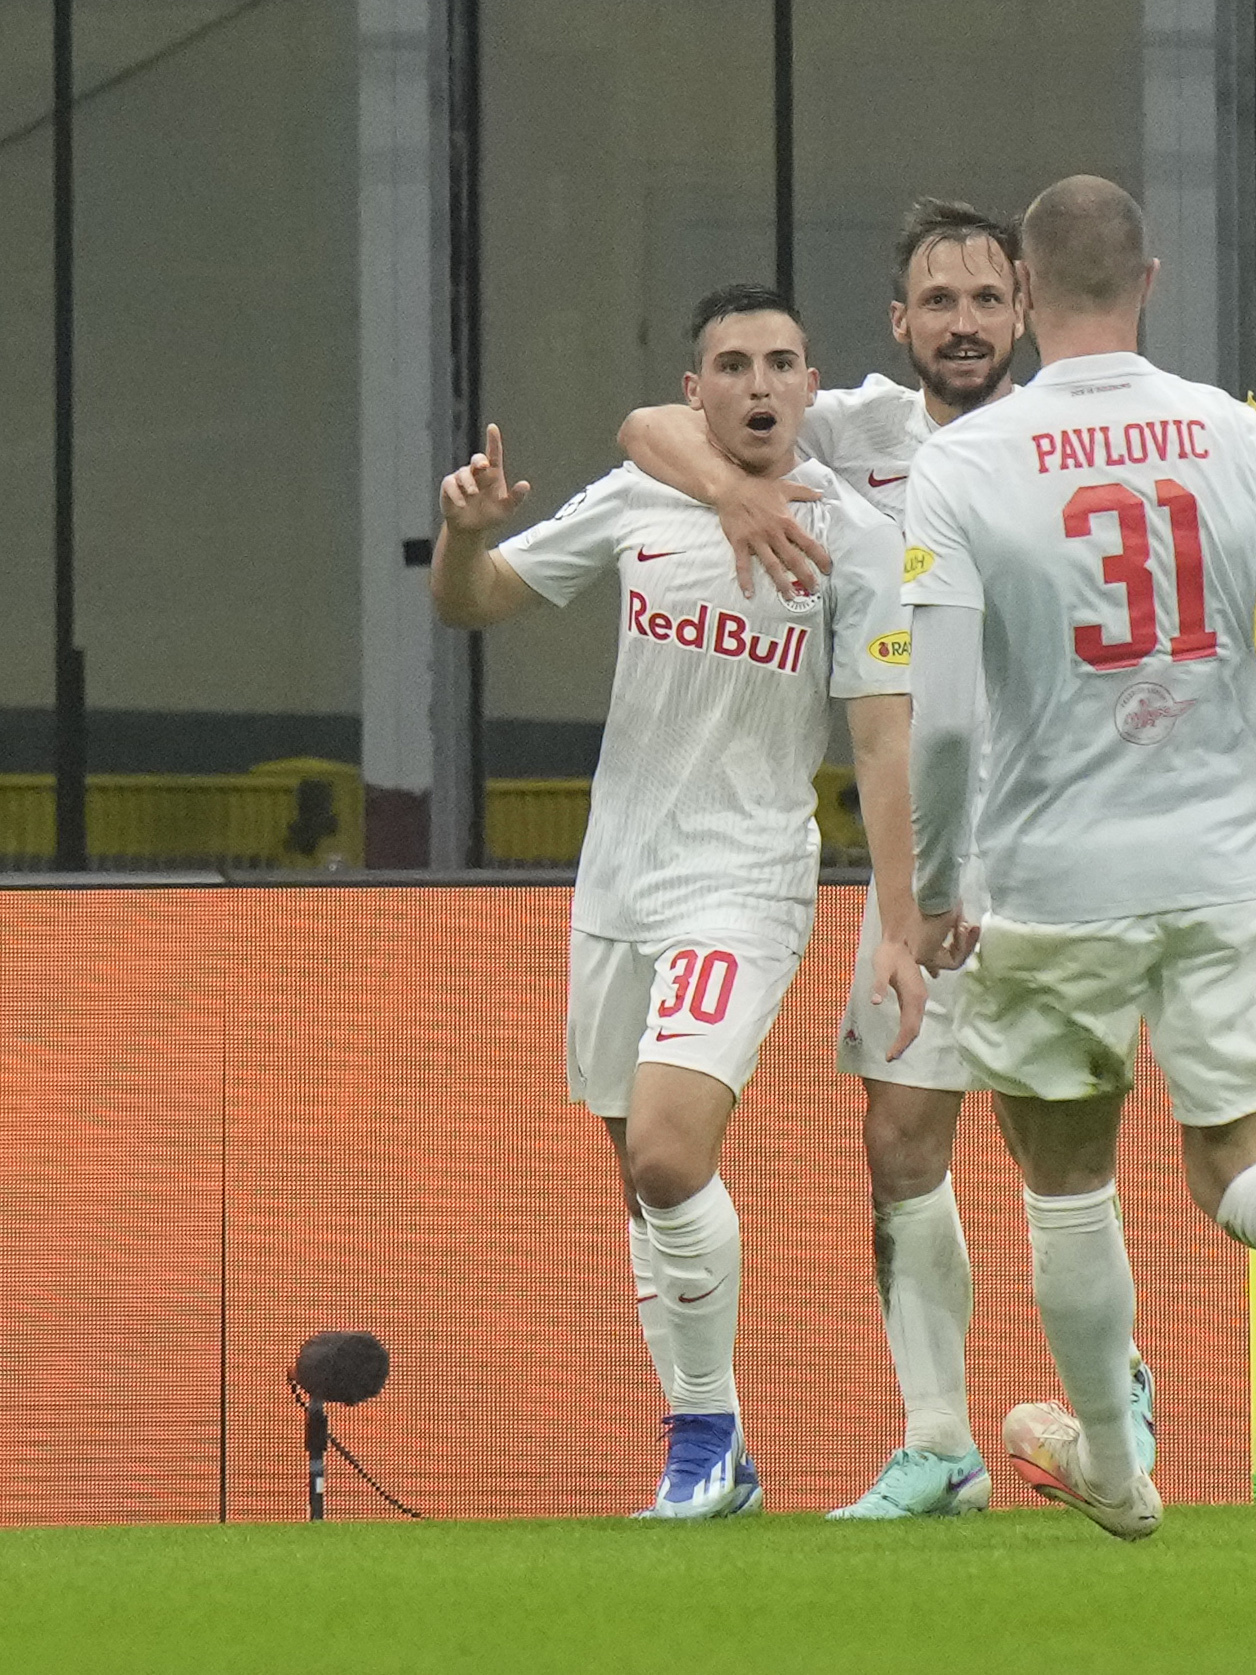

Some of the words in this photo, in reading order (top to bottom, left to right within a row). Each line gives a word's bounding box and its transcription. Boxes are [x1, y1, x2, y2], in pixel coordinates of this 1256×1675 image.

[1032, 419, 1210, 474] PAVLOVIC
[1062, 478, 1217, 671] 31
[657, 949, 738, 1025] 30
